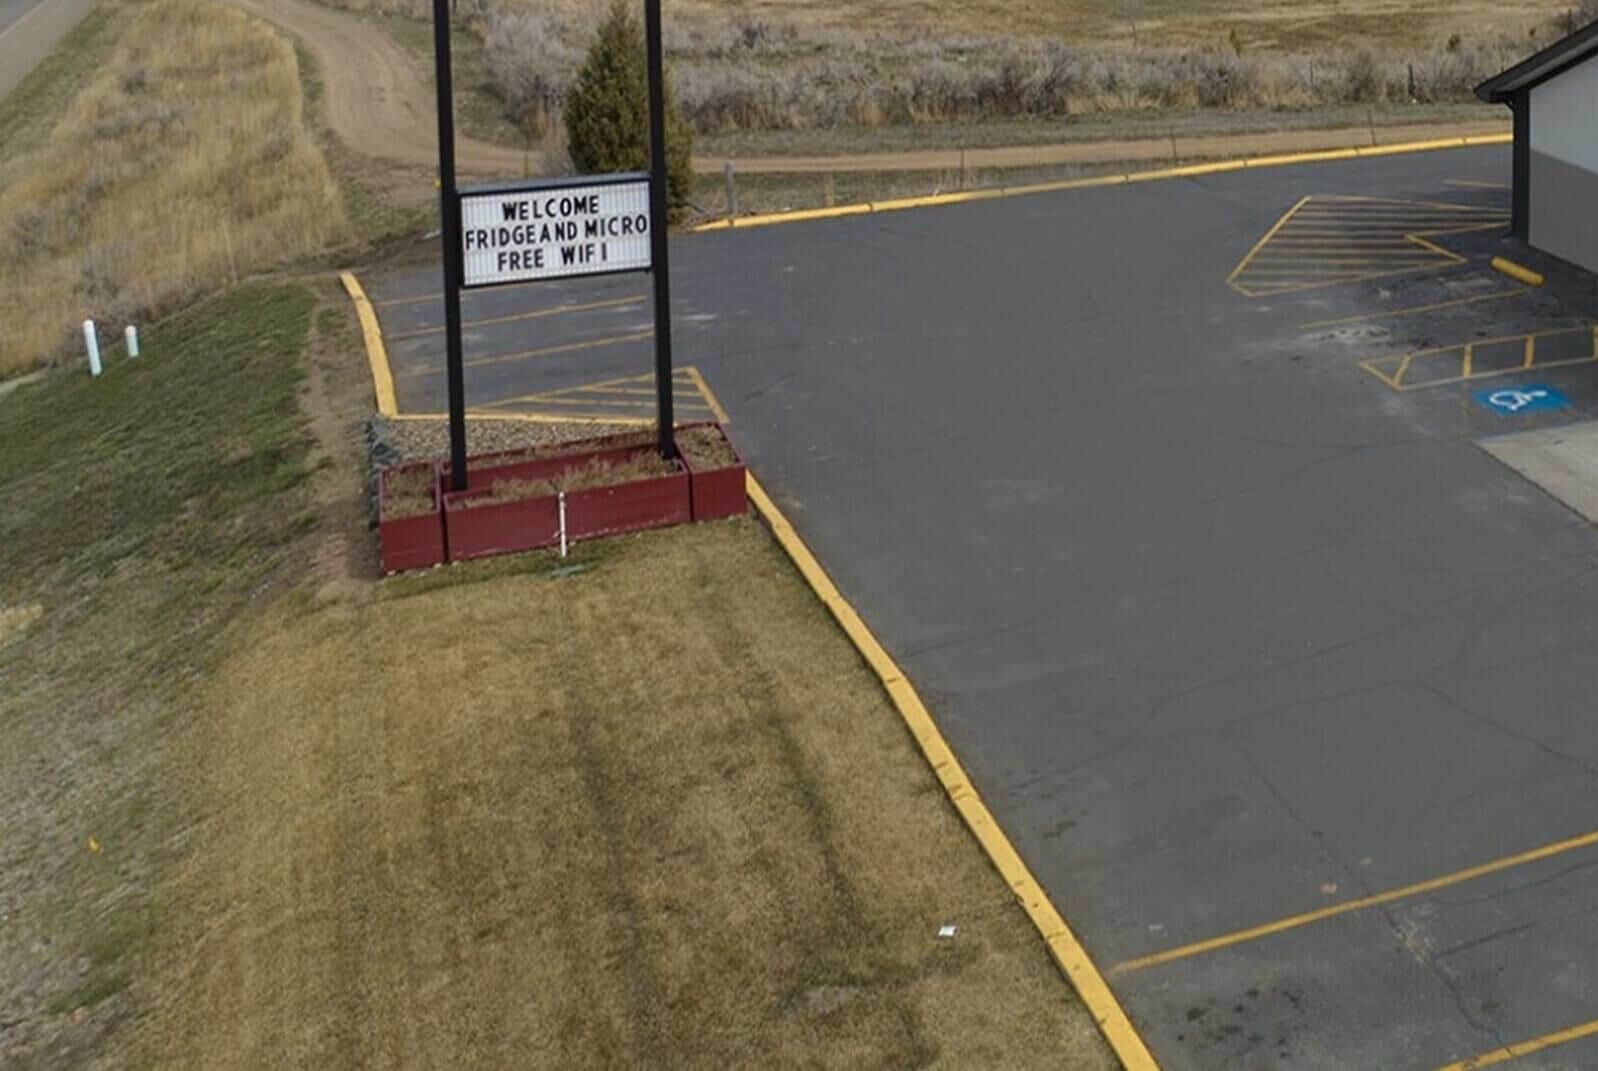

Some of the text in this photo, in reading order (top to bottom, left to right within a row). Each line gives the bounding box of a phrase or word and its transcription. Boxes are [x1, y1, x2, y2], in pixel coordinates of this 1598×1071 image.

[502, 195, 599, 221] WELCOME
[584, 214, 648, 238] MICRO
[497, 248, 544, 272] FREE
